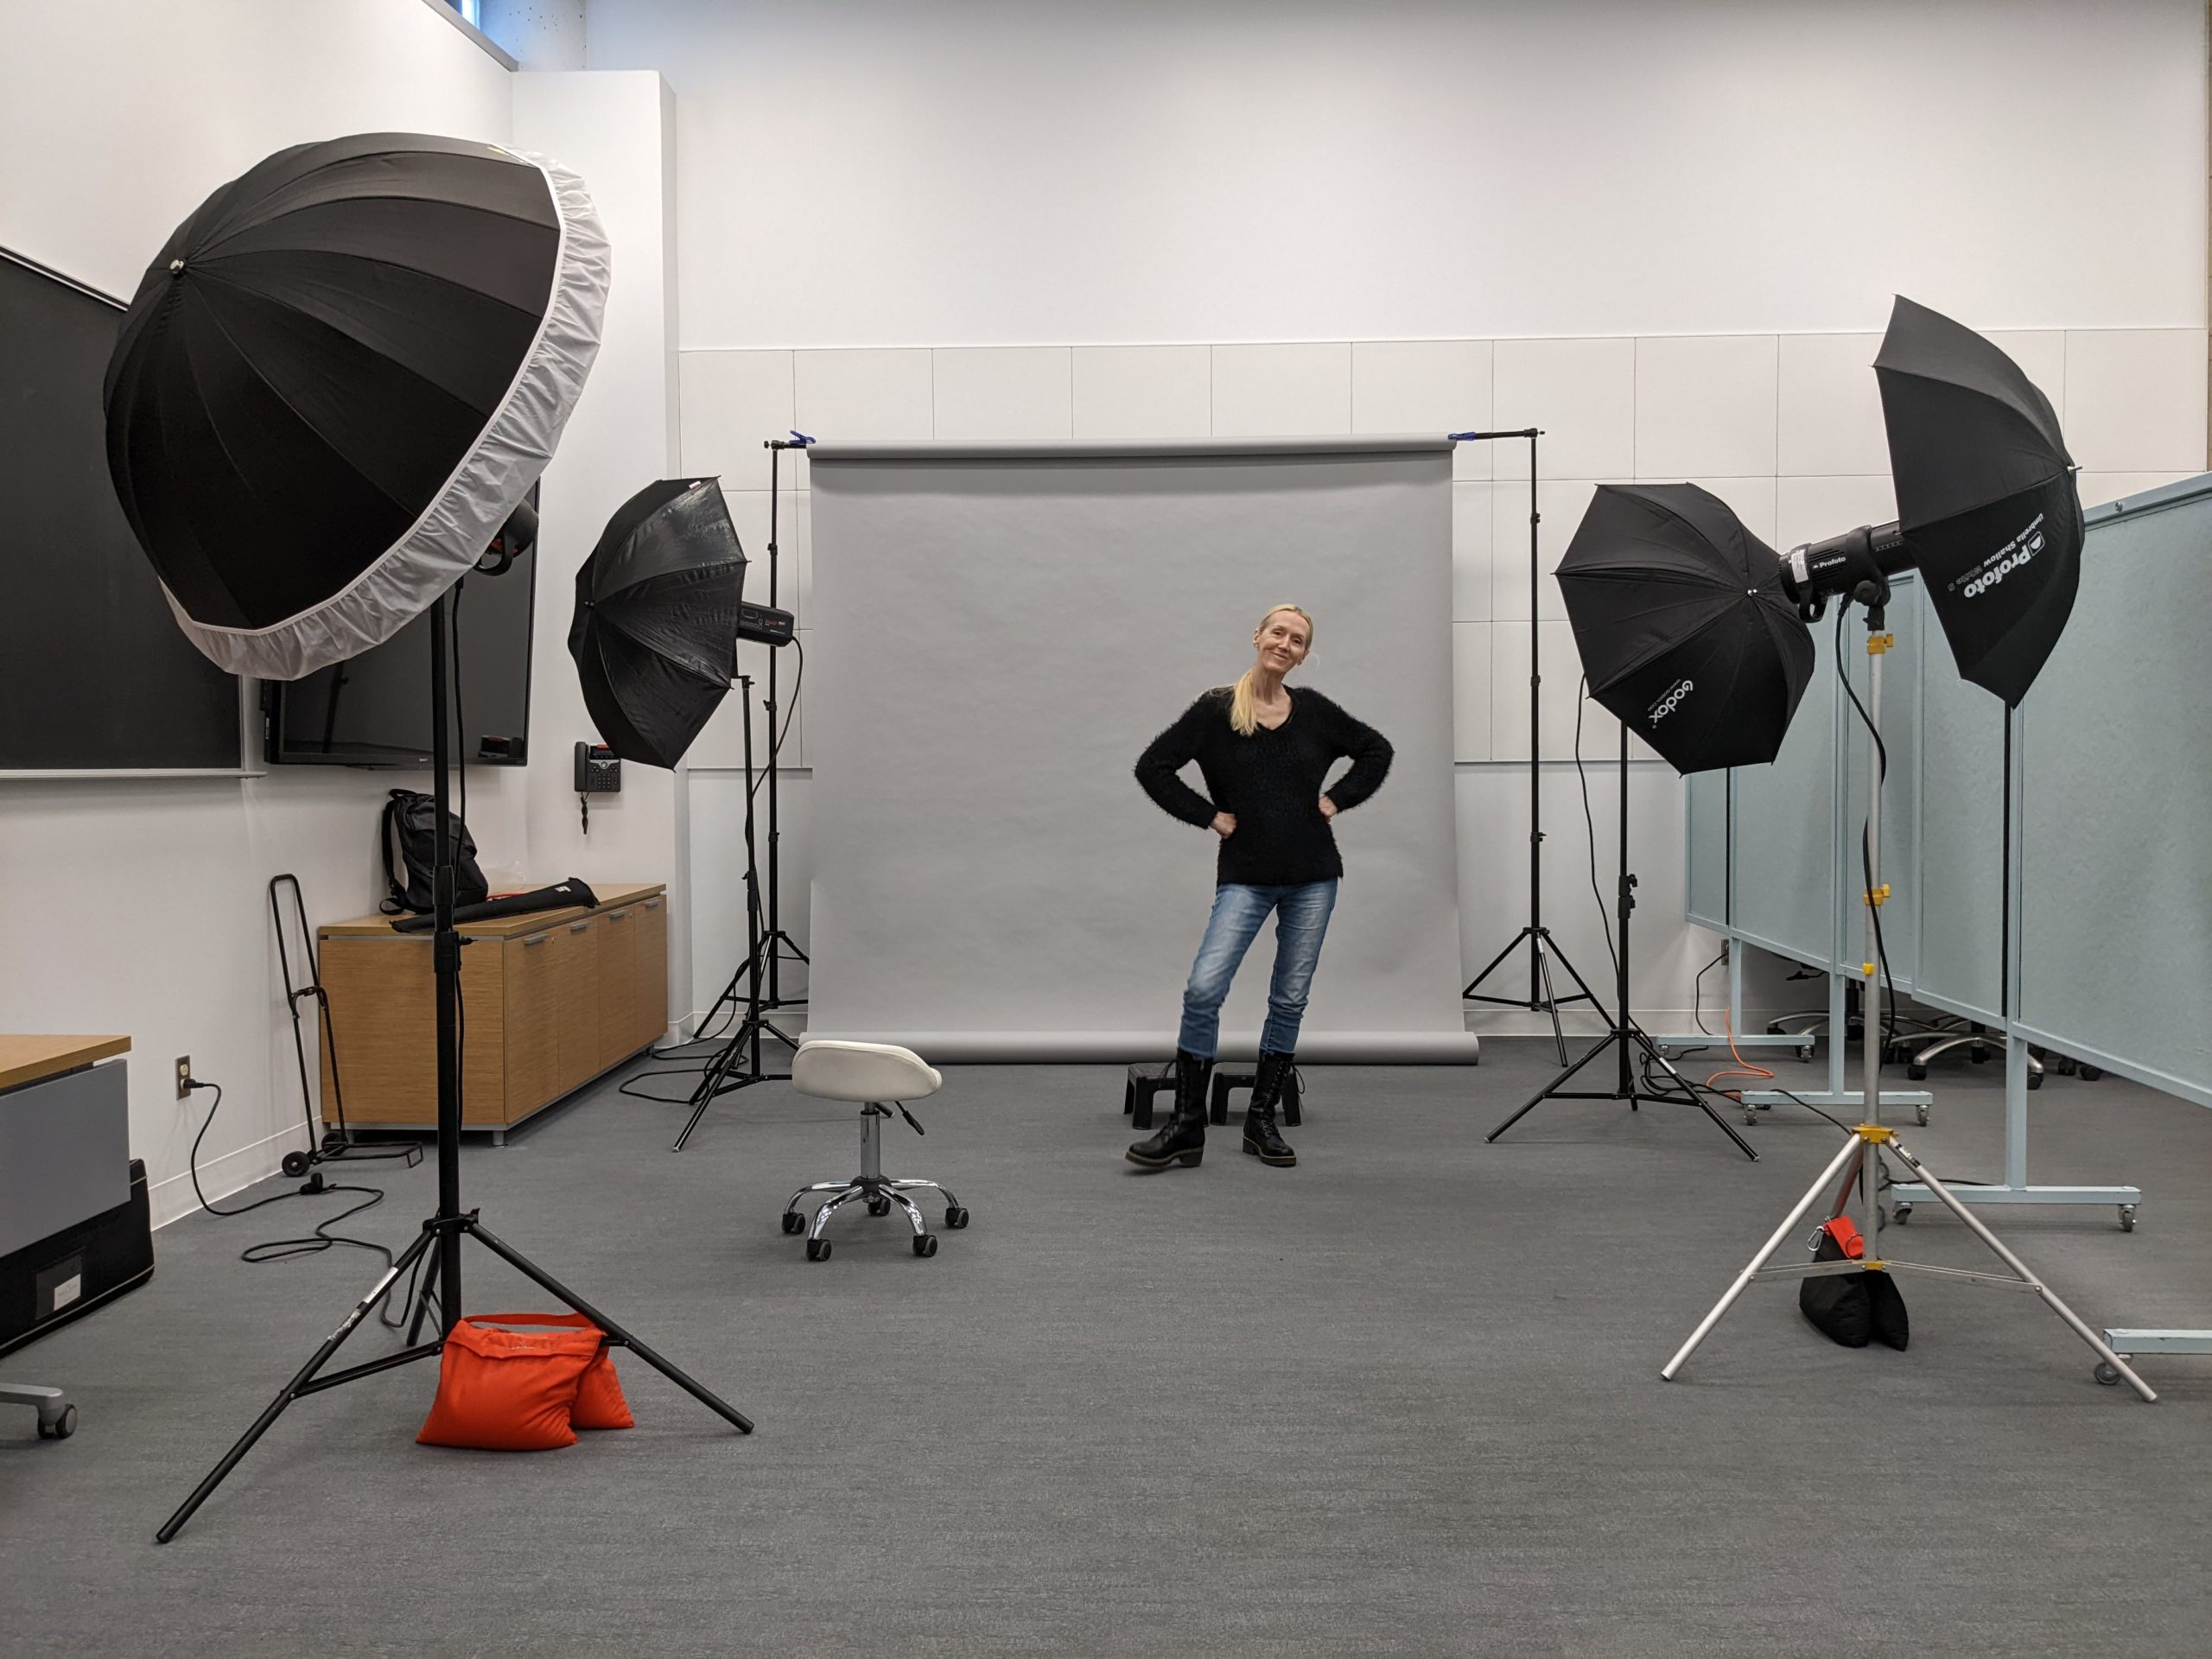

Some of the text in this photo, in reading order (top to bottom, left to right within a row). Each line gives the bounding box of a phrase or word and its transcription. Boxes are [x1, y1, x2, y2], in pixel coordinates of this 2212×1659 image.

[2017, 513, 2044, 543] Umbrella
[1819, 556, 1847, 569] Profoto
[1983, 541, 2017, 567] Shallow
[1963, 545, 2031, 598] Profoto
